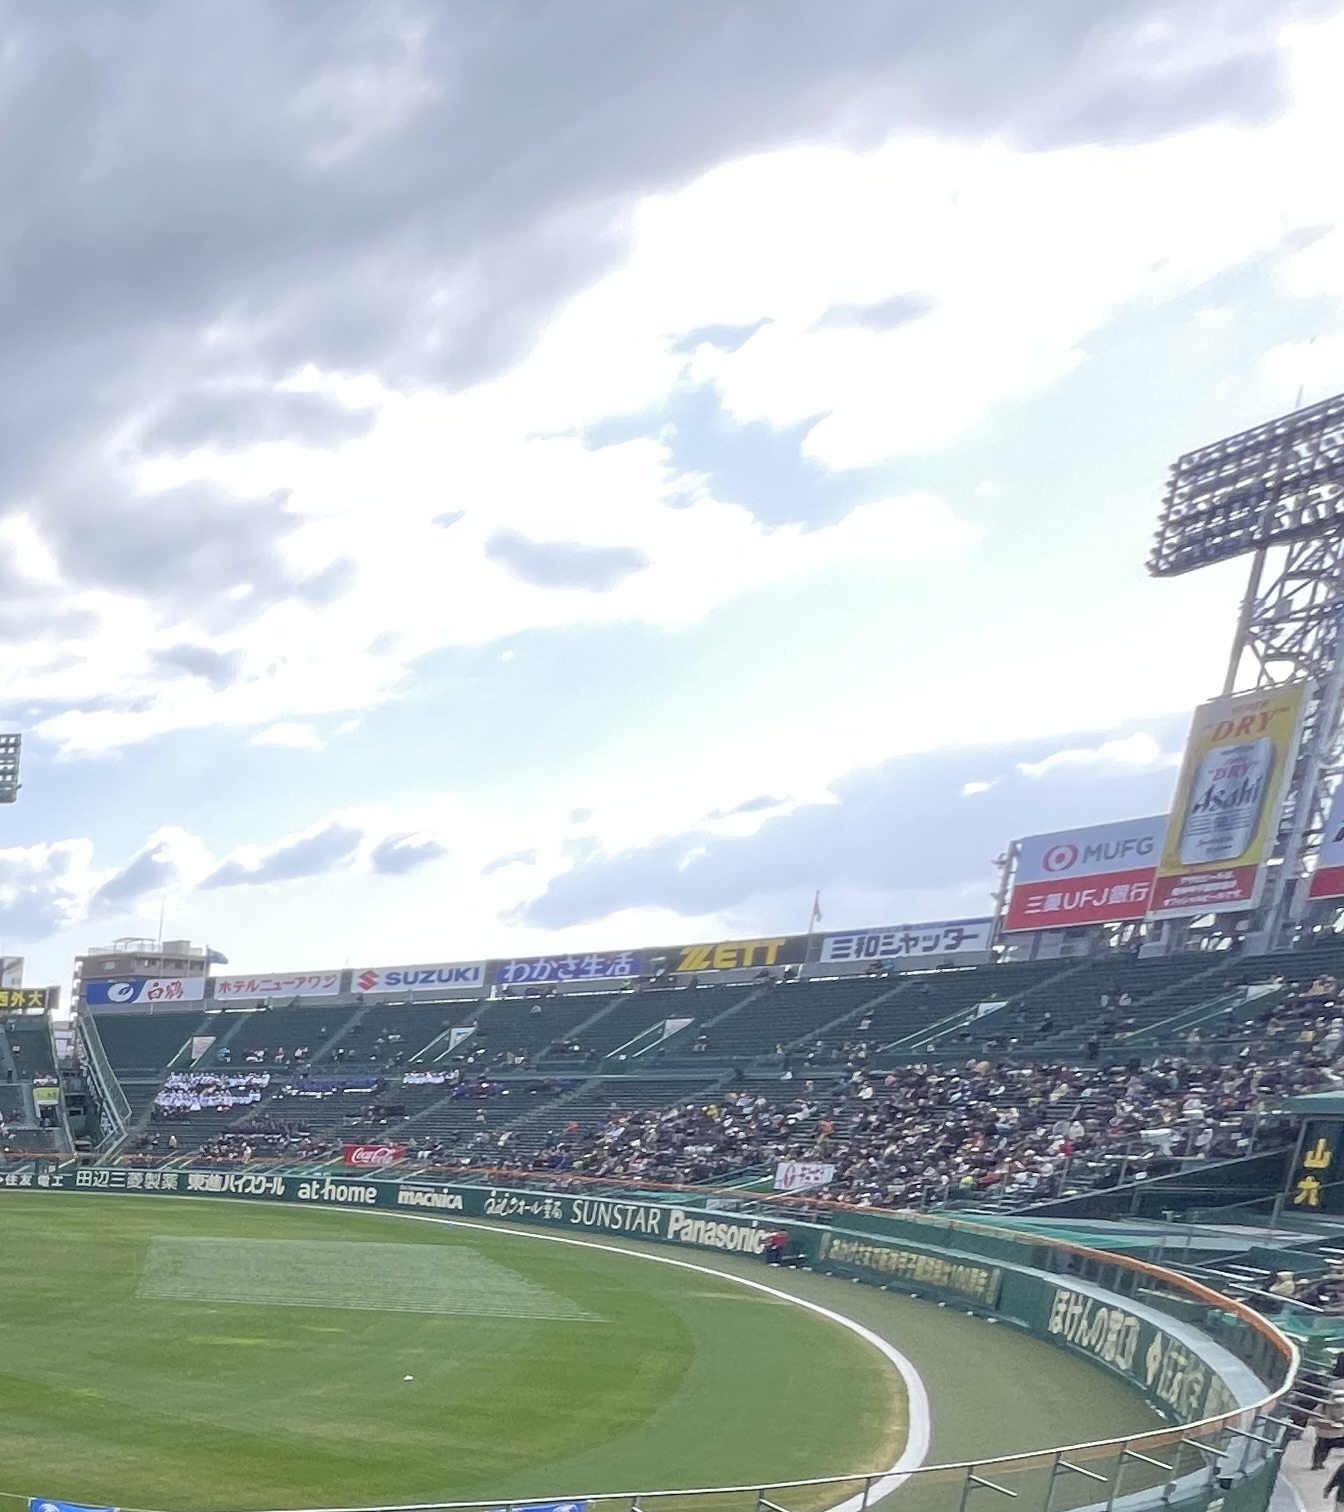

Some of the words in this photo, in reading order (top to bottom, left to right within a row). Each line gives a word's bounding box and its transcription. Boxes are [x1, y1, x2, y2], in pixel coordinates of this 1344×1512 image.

[1082, 836, 1154, 864] MUFG
[1024, 881, 1151, 915] 三菱UFJ銀行
[503, 952, 635, 983] わかさ生活
[678, 938, 787, 972] ZETT
[148, 980, 184, 1000] 白鶴
[385, 966, 481, 986] SUZUKI
[6, 1174, 64, 1187] 住友電工
[76, 1170, 178, 1191] 田辺三菱製薬
[187, 1173, 285, 1196] 東進ハイスクール
[571, 1200, 660, 1234] SUNSTAR
[667, 1210, 769, 1255] Panasonic
[1047, 1289, 1141, 1371] ほけんの窓口
